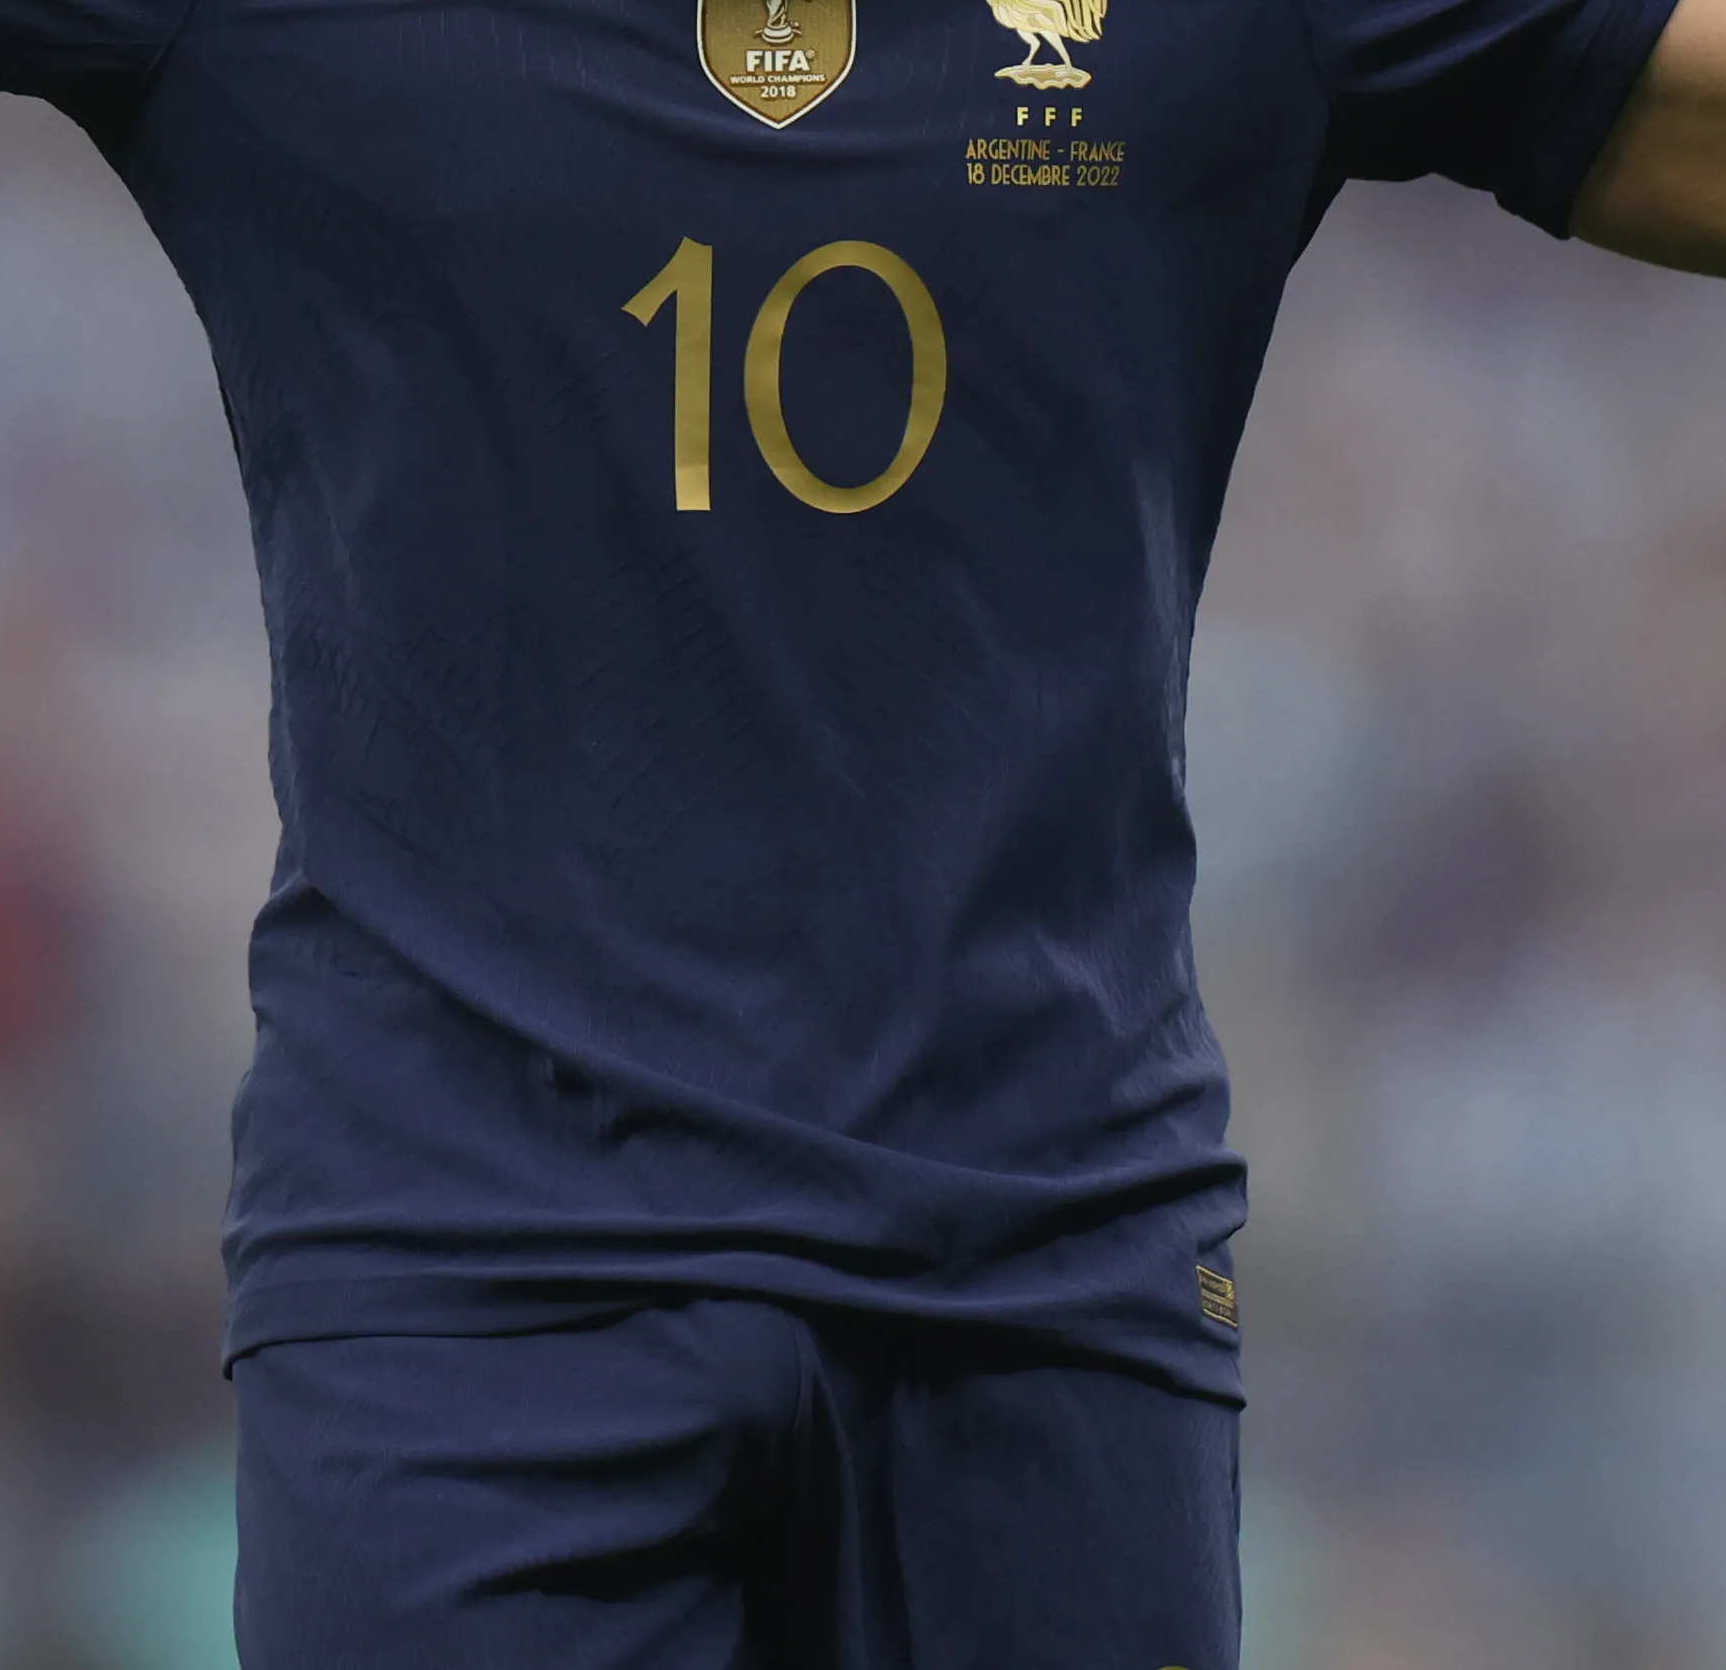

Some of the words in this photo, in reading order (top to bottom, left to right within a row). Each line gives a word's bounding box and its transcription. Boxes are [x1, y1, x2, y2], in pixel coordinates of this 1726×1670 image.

[746, 50, 810, 72] FIFA
[730, 75, 765, 84] WORLD
[767, 74, 826, 83] CHAMPIONS
[760, 85, 796, 98] 2018
[965, 138, 1051, 161] ARGENTINE
[1070, 141, 1126, 162] FRANCE
[966, 163, 986, 185] 18
[991, 163, 1070, 186] DECEMBRE
[1076, 165, 1120, 186] 2022
[621, 236, 947, 514] 10
